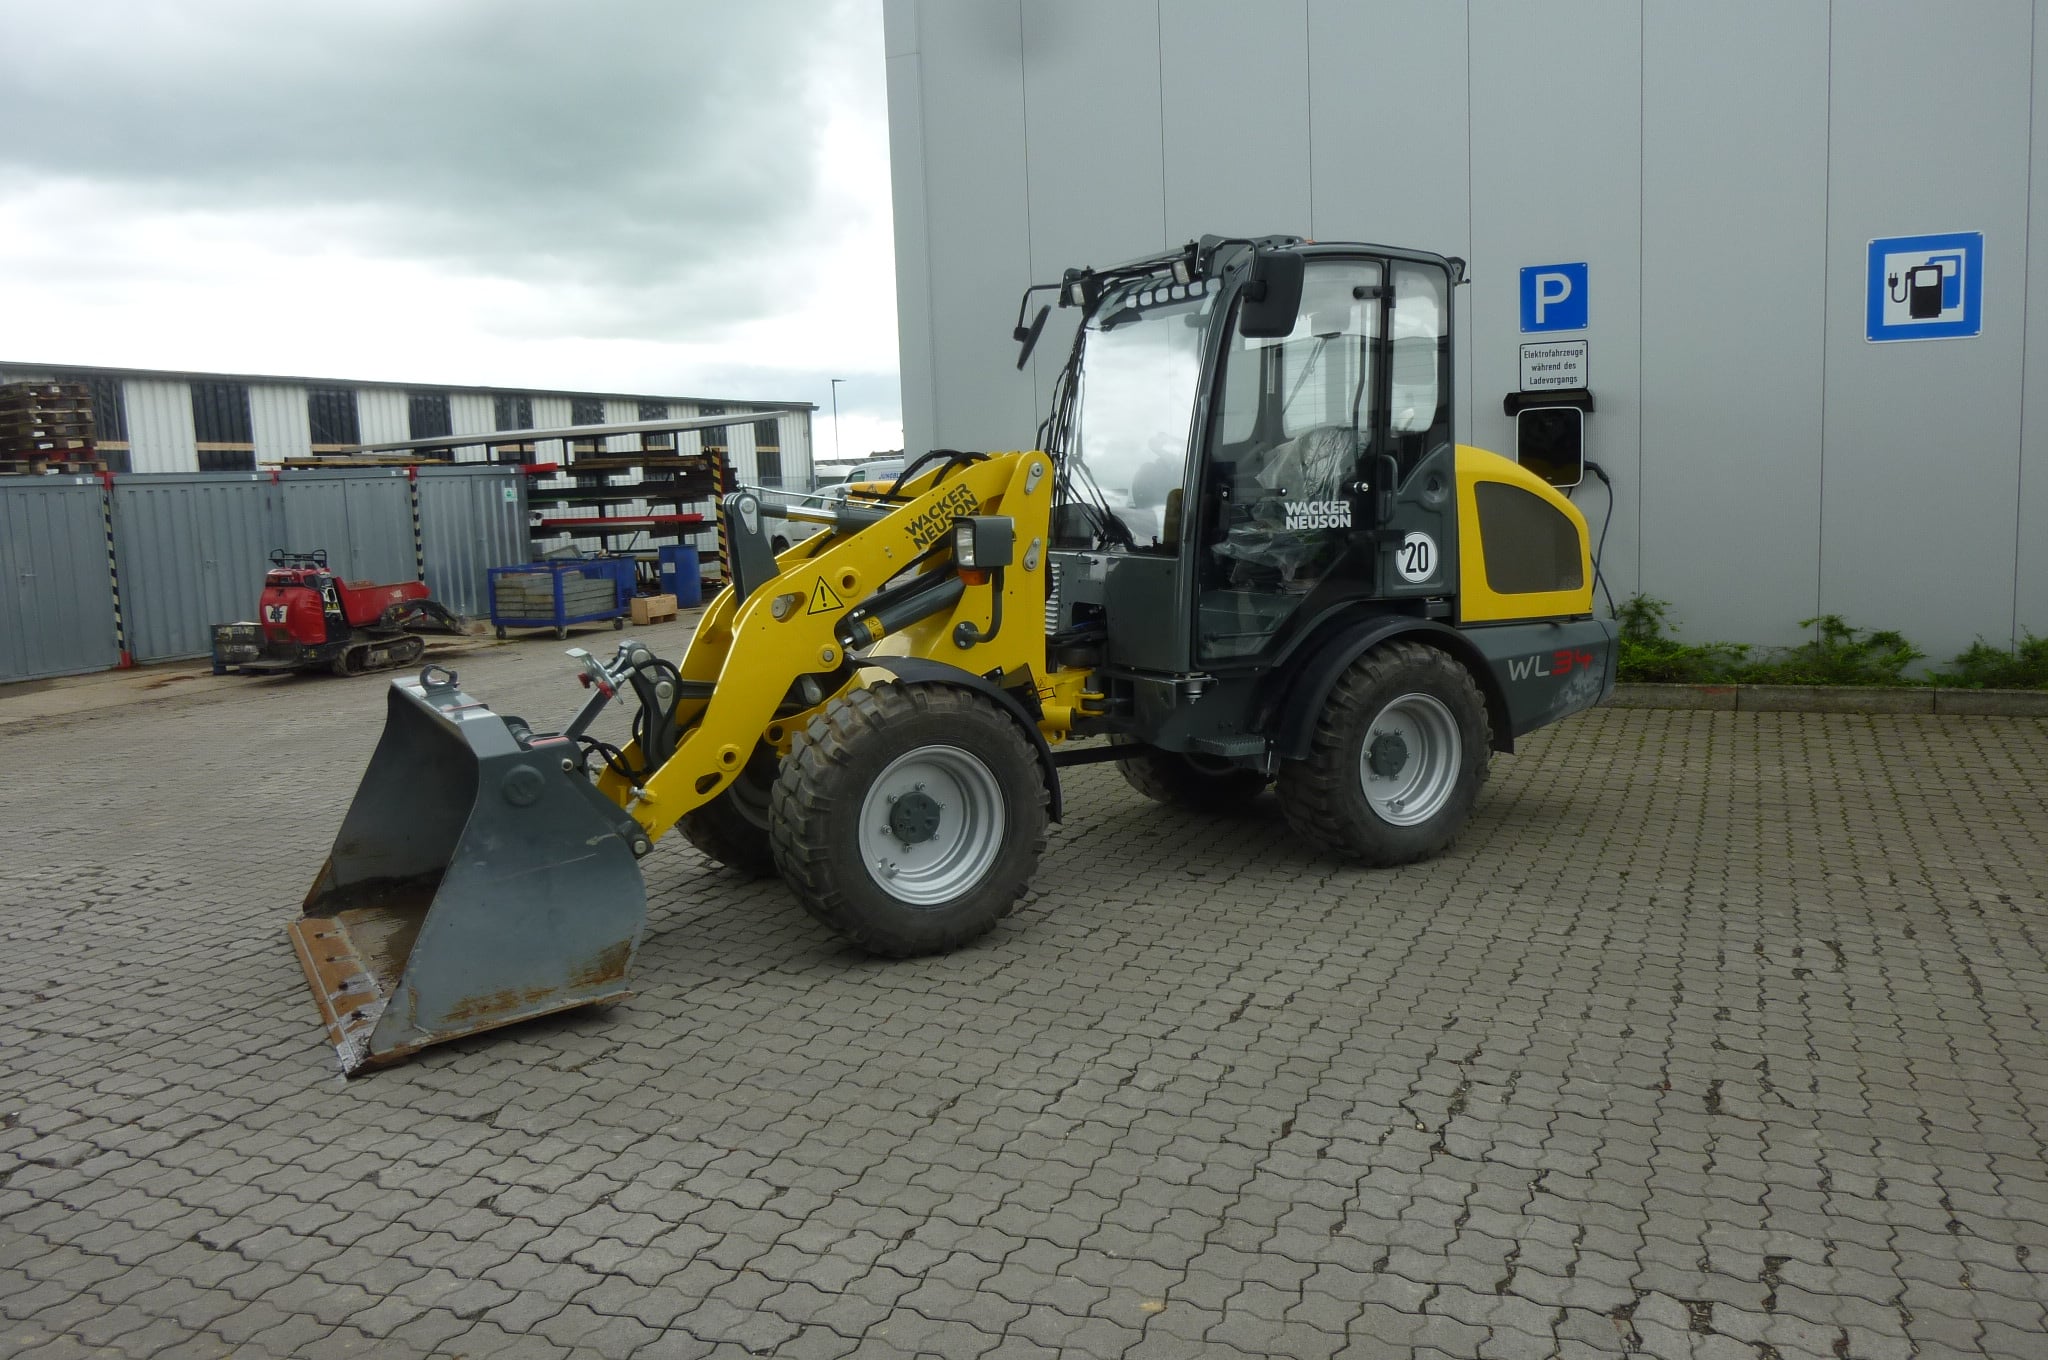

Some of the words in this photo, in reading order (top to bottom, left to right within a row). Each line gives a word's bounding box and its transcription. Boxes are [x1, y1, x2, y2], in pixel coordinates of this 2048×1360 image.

[1535, 272, 1572, 324] P
[1524, 349, 1584, 358] Elektrofahrzeuge
[1531, 362, 1560, 371] während
[1564, 361, 1577, 369] des
[1529, 376, 1578, 385] Ladevorgangs
[904, 483, 971, 536] WACKER
[1284, 500, 1352, 515] WACKER
[1285, 515, 1352, 530] NEUSON
[1404, 541, 1429, 574] 20
